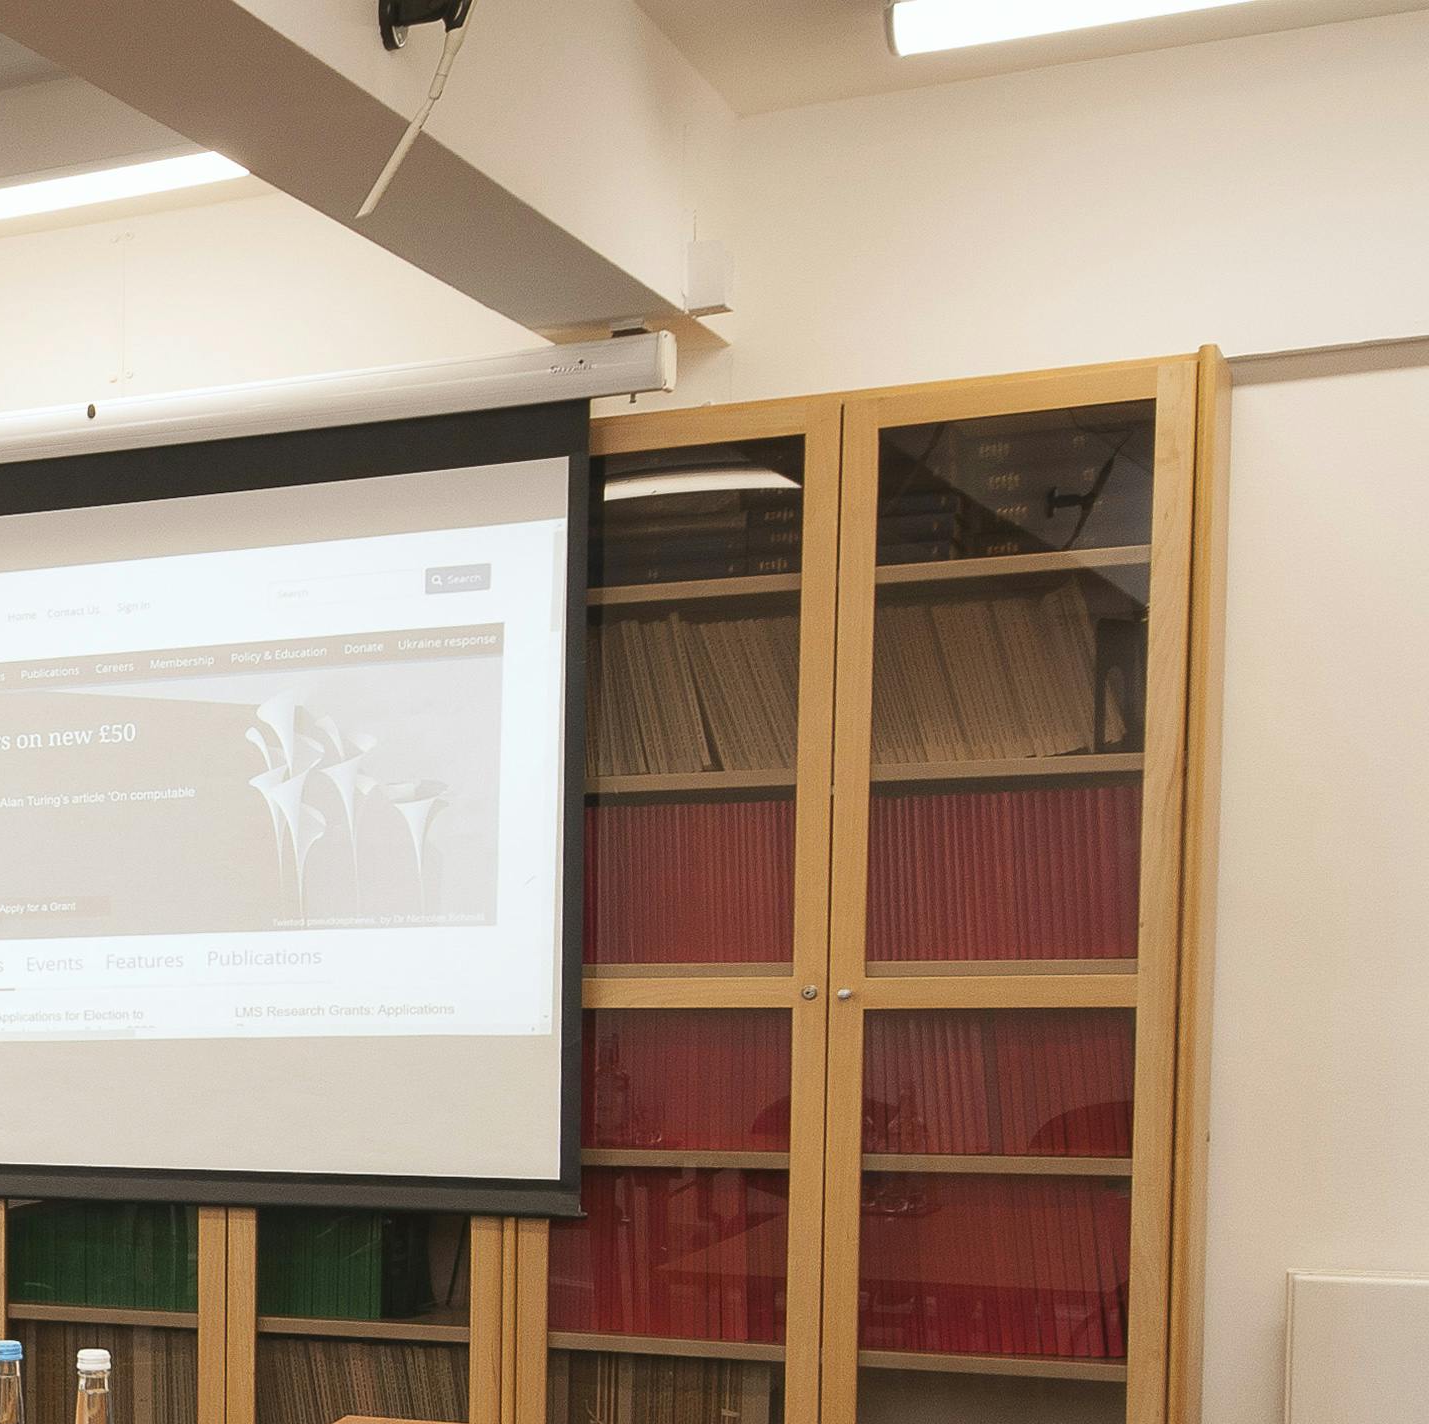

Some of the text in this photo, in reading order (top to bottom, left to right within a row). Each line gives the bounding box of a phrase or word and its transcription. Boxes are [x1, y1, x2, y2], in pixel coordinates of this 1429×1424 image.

[447, 572, 482, 585] Search
[7, 610, 37, 623] Home
[47, 607, 83, 619] Contact
[344, 640, 384, 655] Donate
[398, 633, 497, 651] Ukraine response
[150, 655, 215, 671] Membership
[231, 646, 328, 665] Policy & Education
[20, 665, 80, 680] Publications
[95, 661, 134, 674] Careers
[16, 730, 42, 748] on
[48, 727, 93, 746] new
[98, 722, 136, 744] £50
[0, 797, 25, 809] Alan
[27, 794, 70, 809] Turing's
[71, 792, 105, 804] article
[130, 787, 196, 803] computable
[0, 903, 24, 915] Apply
[26, 903, 38, 913] for
[49, 901, 77, 913] Grant
[25, 953, 83, 973] Events
[105, 951, 185, 971] Features
[206, 947, 323, 968] Publications
[64, 1009, 80, 1021] for
[83, 1008, 129, 1021] Election
[132, 1009, 144, 1020] to
[234, 1002, 455, 1018] LMS Research Grants: Applications
